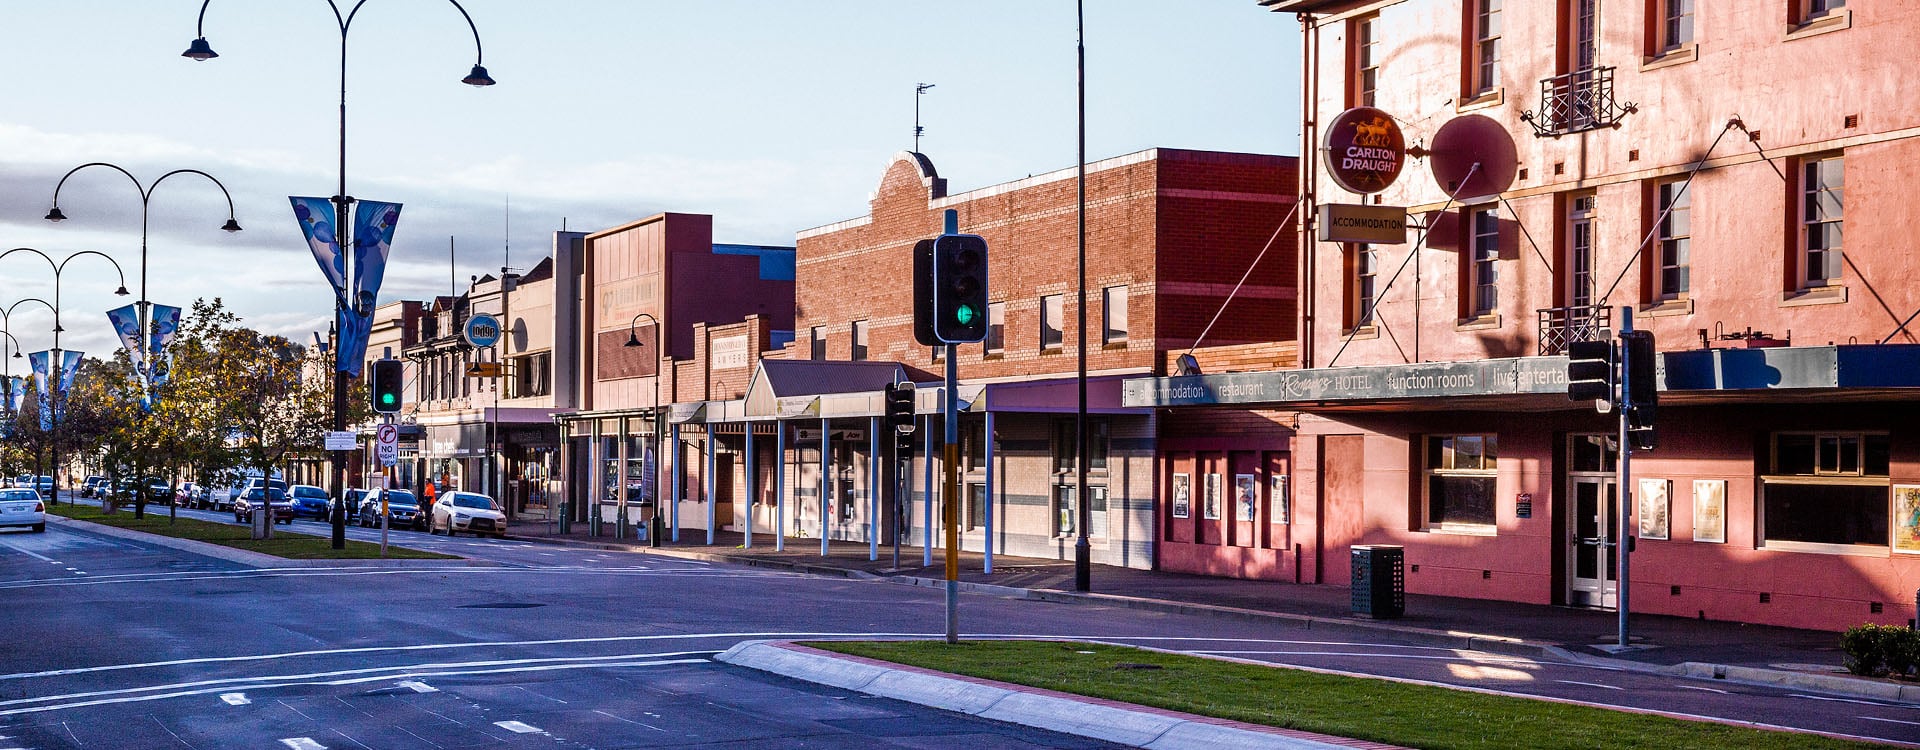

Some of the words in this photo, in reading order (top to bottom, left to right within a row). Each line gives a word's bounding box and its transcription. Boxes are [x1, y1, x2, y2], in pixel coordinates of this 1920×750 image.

[1346, 146, 1396, 161] CARLTON
[1342, 158, 1397, 172] DRAUGHT
[1332, 217, 1403, 230] ACCOMMODATION
[472, 324, 495, 338] Lodge
[1140, 383, 1204, 400] aommodation
[1219, 381, 1264, 397] restaurant
[1334, 375, 1372, 390] HOTEL
[1387, 371, 1434, 390] function
[1437, 373, 1475, 388] rooms
[1493, 367, 1514, 385] live
[381, 445, 393, 453] NO
